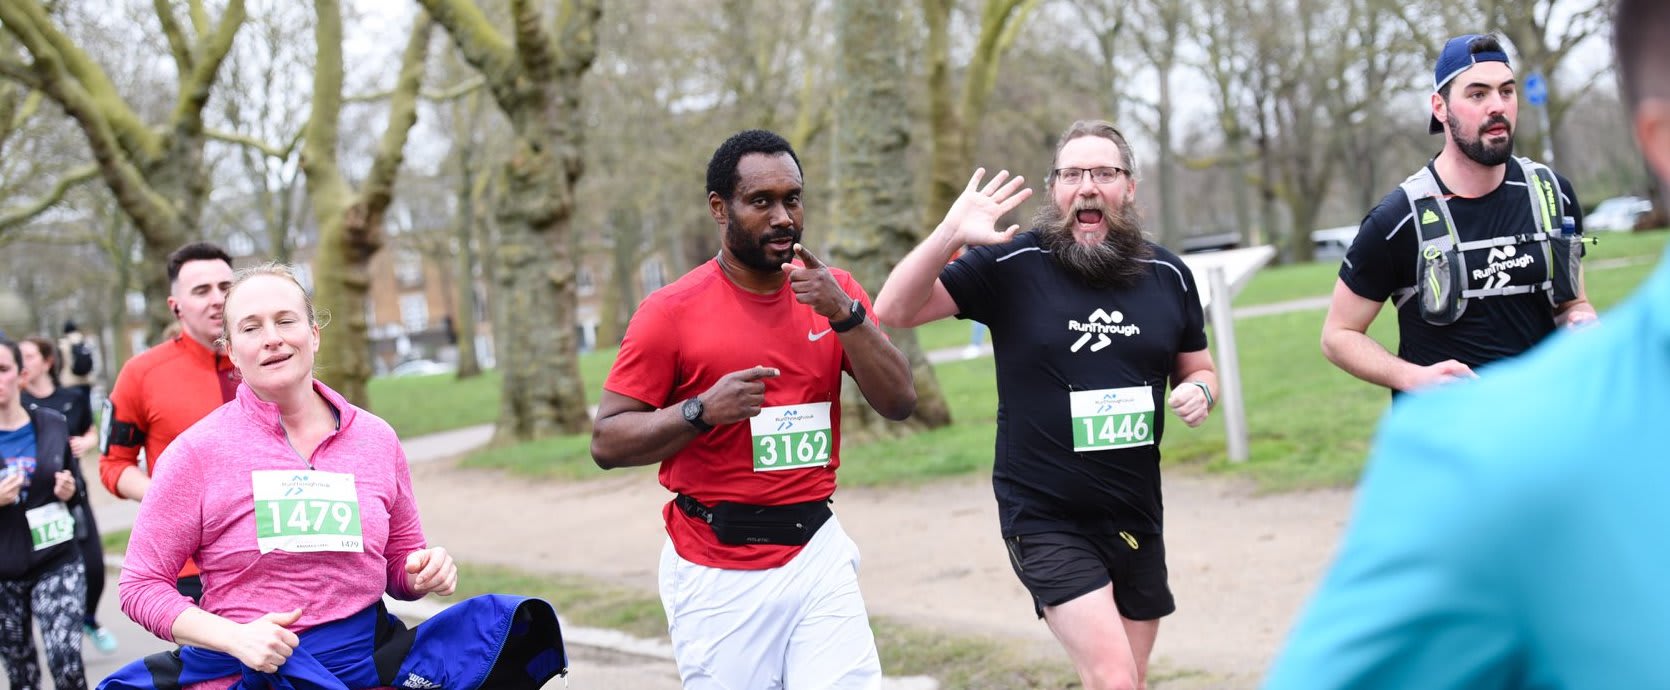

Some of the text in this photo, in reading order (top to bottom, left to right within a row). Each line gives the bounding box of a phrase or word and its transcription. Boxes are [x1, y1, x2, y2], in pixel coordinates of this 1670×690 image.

[1472, 253, 1534, 280] RunThrough
[1068, 320, 1140, 337] RunThrough
[1083, 413, 1149, 445] 1446
[759, 431, 828, 466] 3162
[268, 501, 353, 534] 1479
